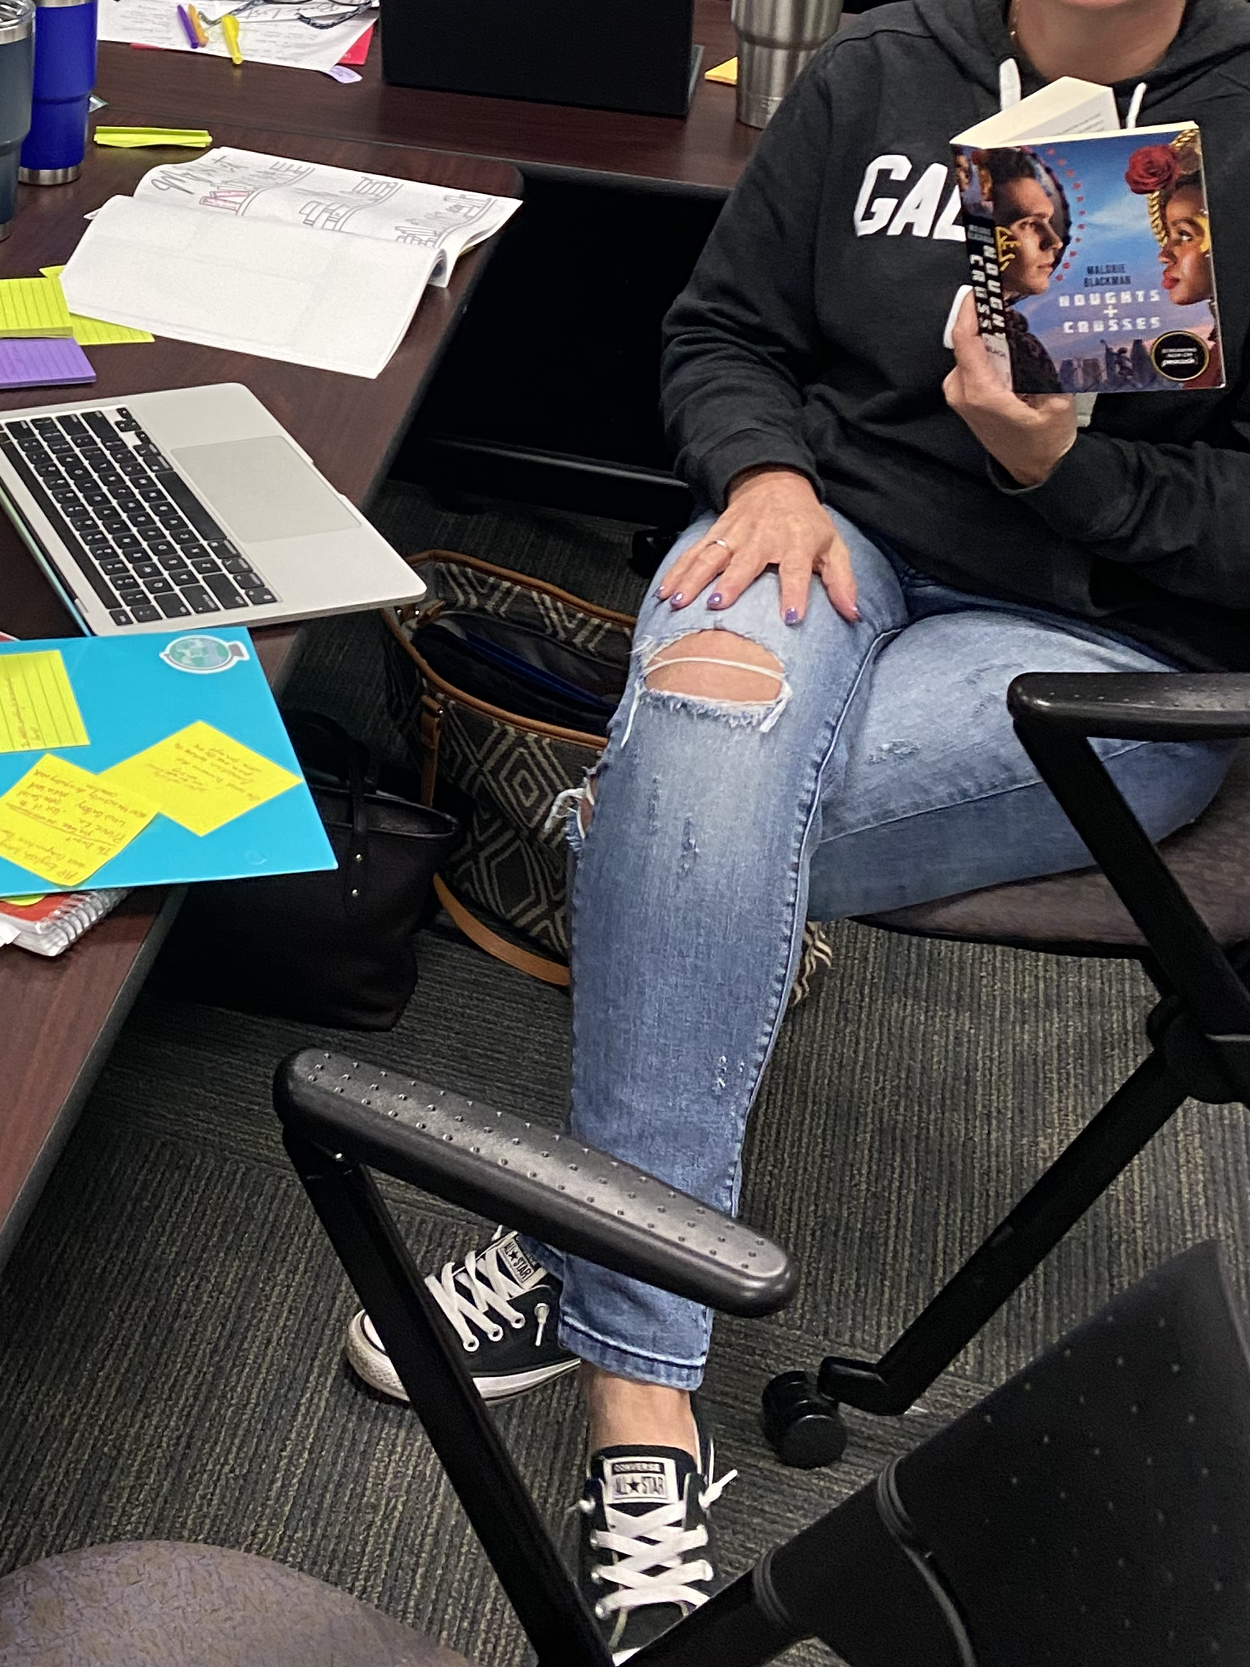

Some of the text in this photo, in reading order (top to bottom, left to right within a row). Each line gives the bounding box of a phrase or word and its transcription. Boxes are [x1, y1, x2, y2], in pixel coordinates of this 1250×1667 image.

[982, 245, 1006, 329] NOUGH
[1084, 276, 1131, 288] BLACKMAN
[970, 254, 992, 330] CROSS
[1059, 289, 1161, 307] NOUGHTS
[1063, 317, 1161, 333] CROSSES
[503, 1241, 516, 1255] ALL
[514, 1256, 532, 1279] STAR
[613, 1476, 664, 1495] ALL STAR
